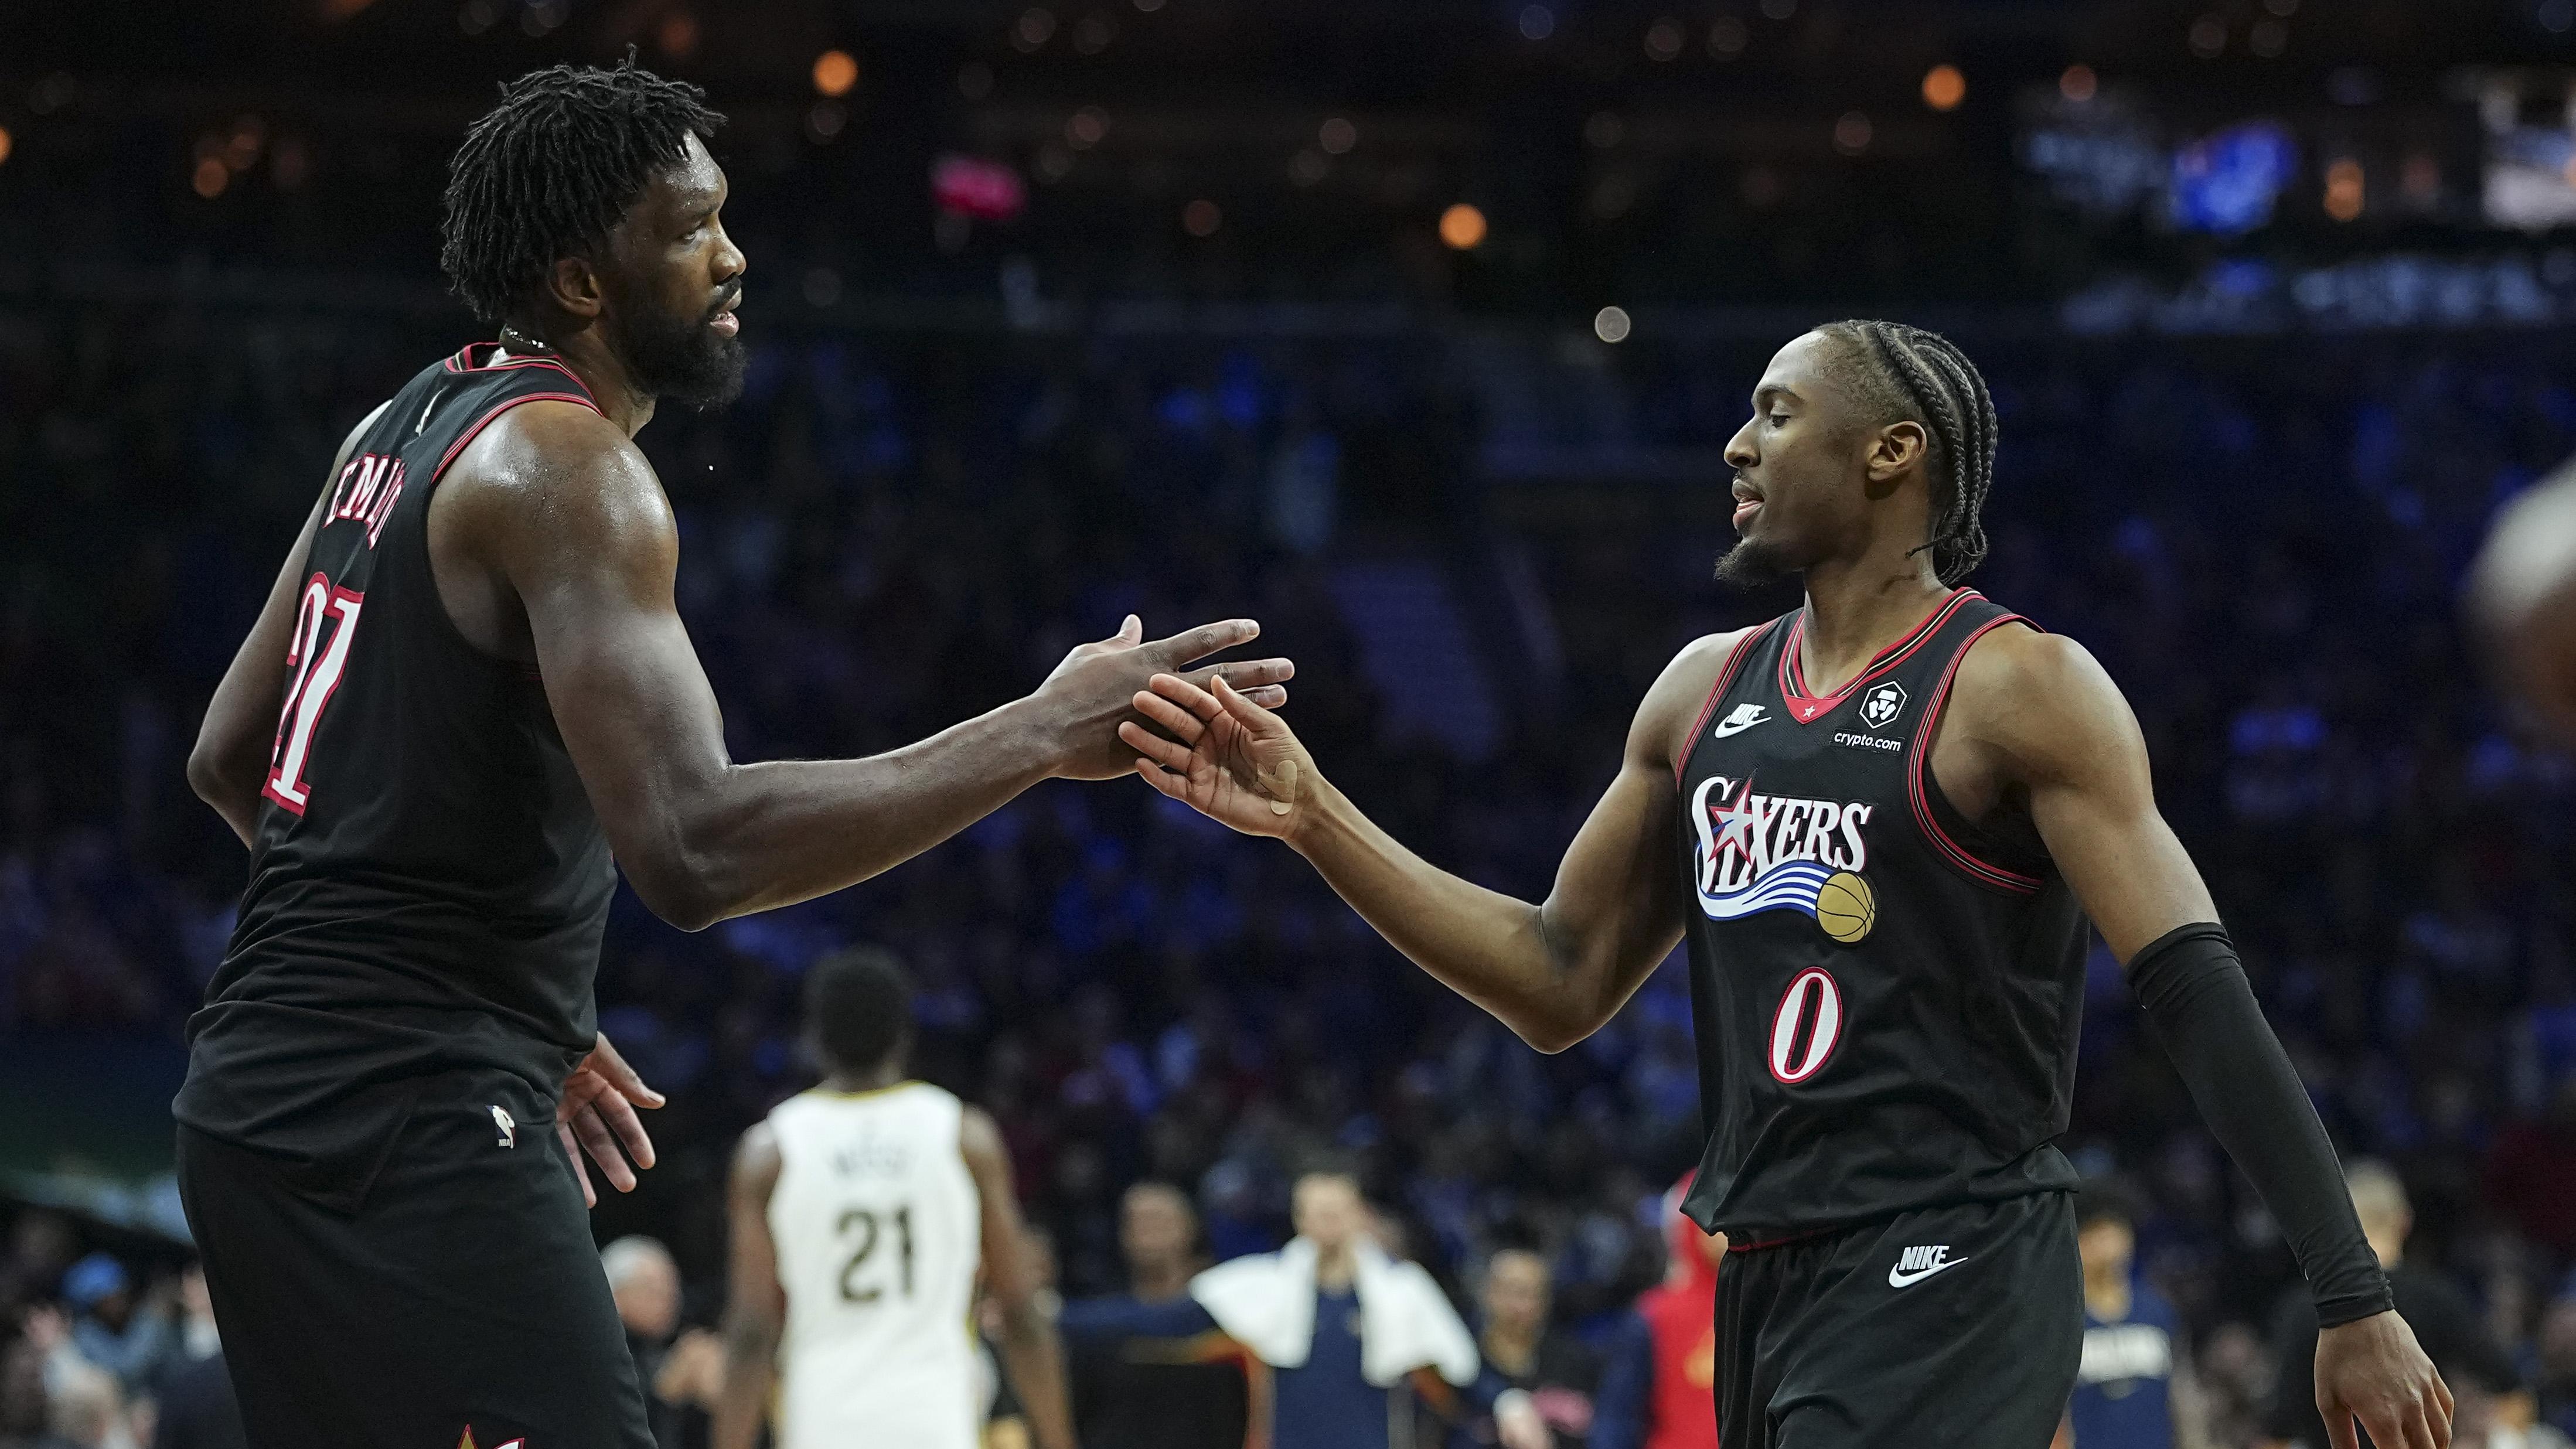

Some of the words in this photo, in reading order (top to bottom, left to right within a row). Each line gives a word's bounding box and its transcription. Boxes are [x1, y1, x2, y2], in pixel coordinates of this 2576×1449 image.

[261, 571, 365, 817] 21
[1726, 703, 1766, 725] NIKE
[1834, 733, 1901, 751] crypto.com
[1769, 967, 1842, 1084] 0
[498, 1138, 511, 1147] NBA
[833, 1205, 915, 1303] 21
[1899, 1246, 1950, 1270] NIKE
